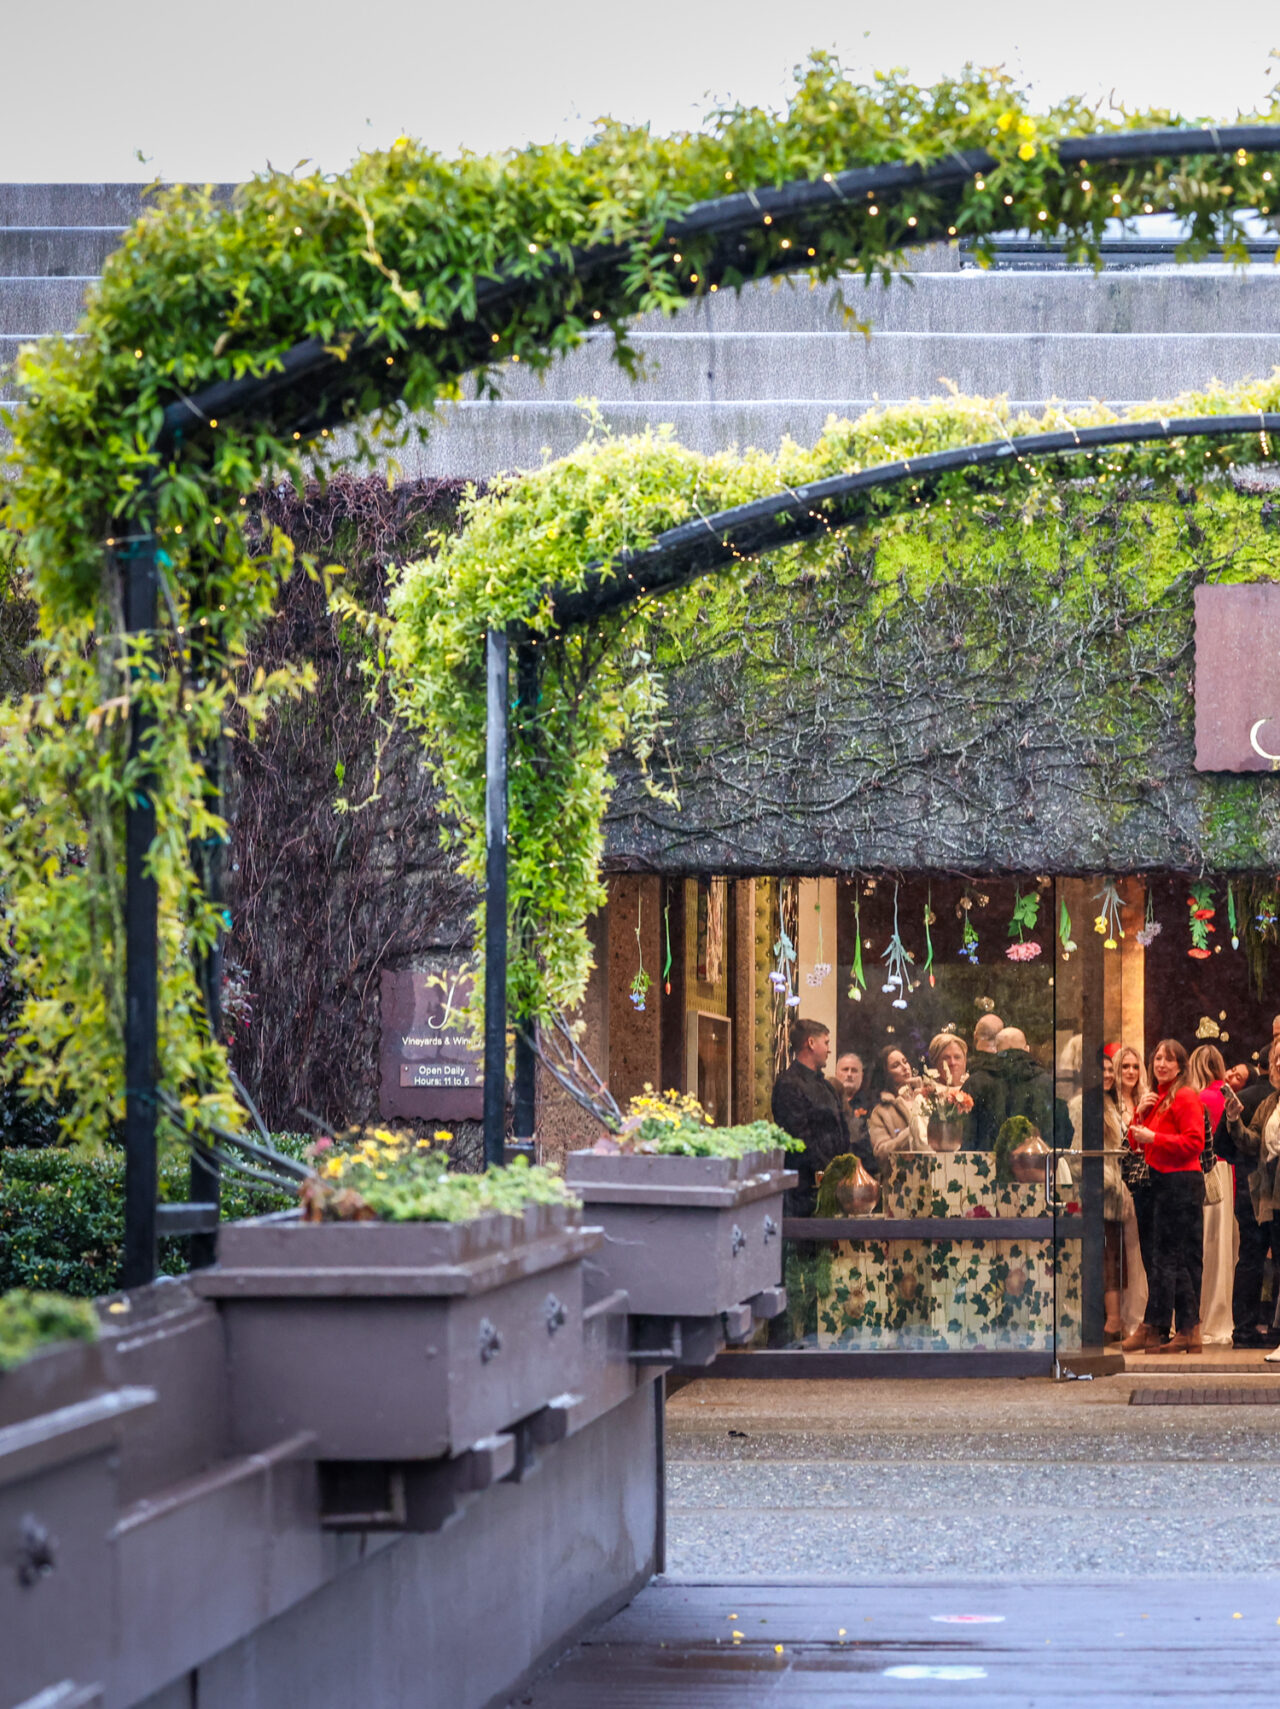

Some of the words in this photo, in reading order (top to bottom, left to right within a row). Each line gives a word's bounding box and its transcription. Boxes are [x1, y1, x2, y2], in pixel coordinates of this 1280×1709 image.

[402, 1036, 442, 1047] Vineyards
[444, 1036, 450, 1045] &
[419, 1065, 442, 1076] Open
[444, 1065, 465, 1076] Daily
[414, 1076, 442, 1086] Hours:
[444, 1077, 451, 1086] 11
[453, 1076, 462, 1086] to
